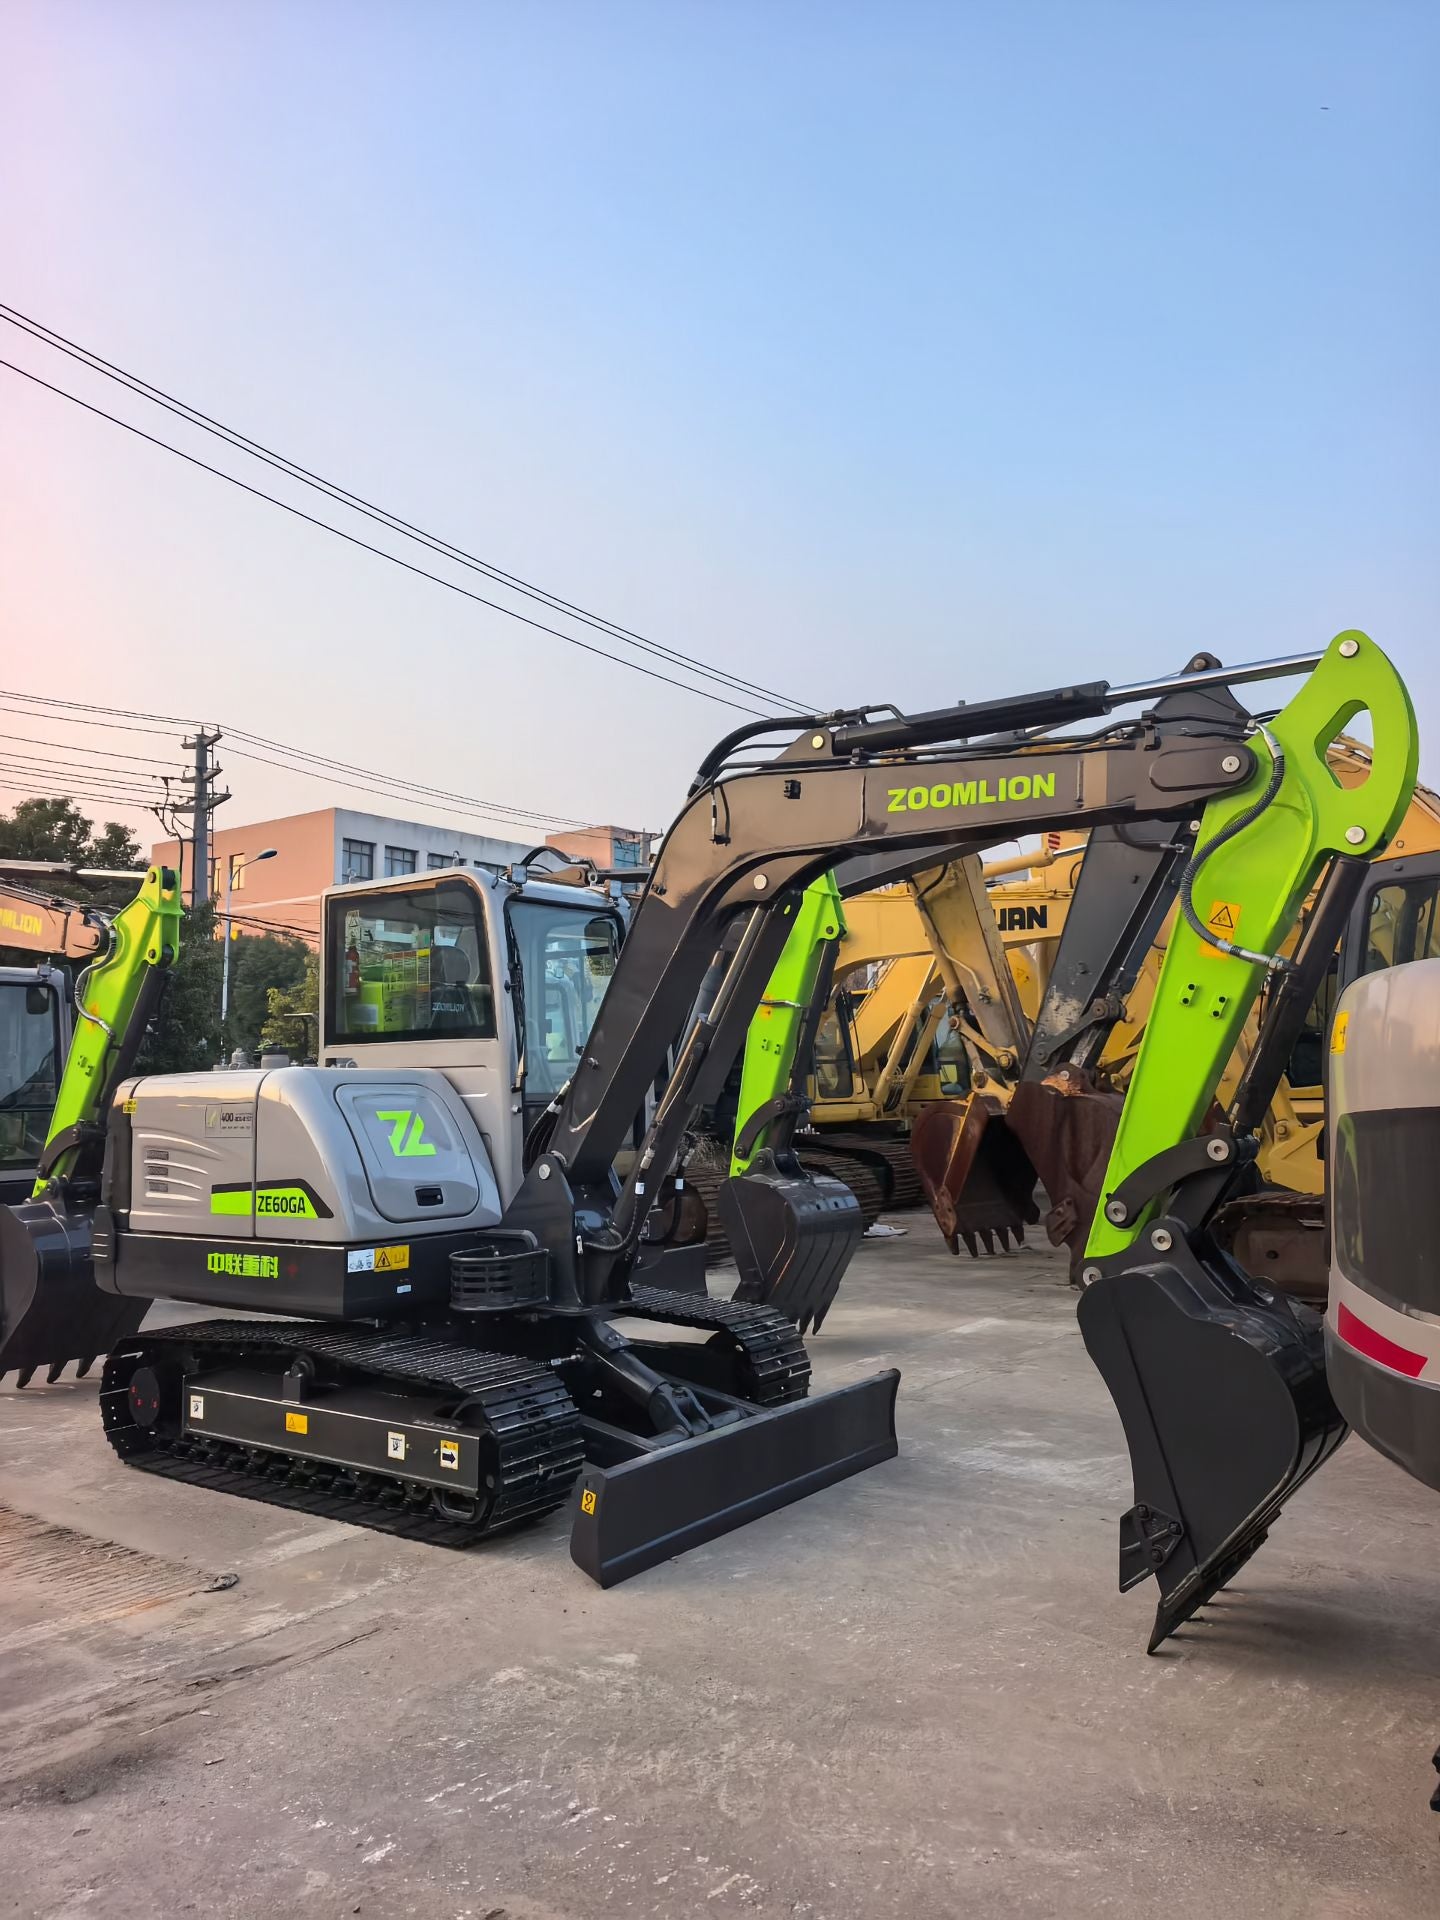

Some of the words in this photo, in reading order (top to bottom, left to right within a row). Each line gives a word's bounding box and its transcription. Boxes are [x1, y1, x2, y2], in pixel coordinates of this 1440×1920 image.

[887, 772, 1056, 812] ZOOMLION
[0, 908, 42, 936] MLION
[257, 1195, 306, 1214] ZE60GA
[207, 1252, 279, 1279] 中联重科
